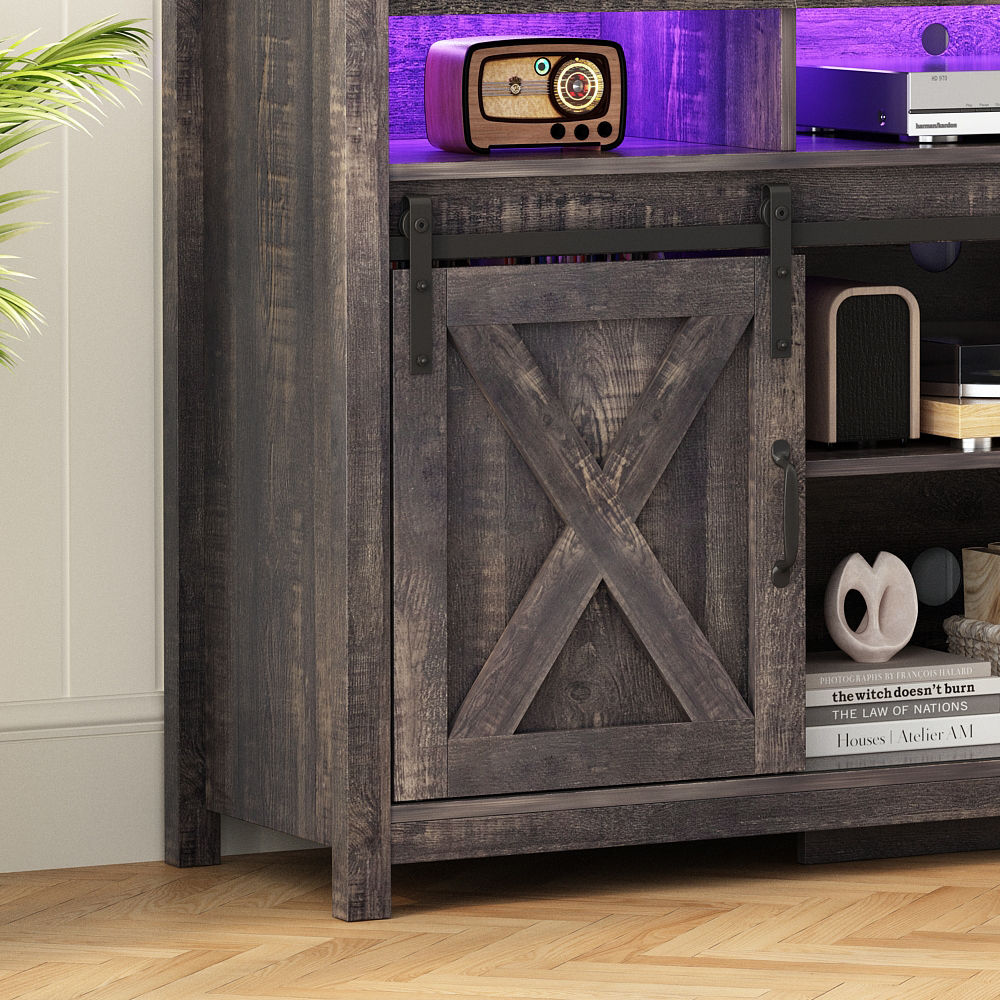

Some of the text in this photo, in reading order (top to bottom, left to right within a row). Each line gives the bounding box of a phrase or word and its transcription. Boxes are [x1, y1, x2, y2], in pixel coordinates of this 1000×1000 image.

[820, 672, 883, 686] PHOTOGRAPHS
[884, 672, 895, 681] BY
[939, 665, 973, 677] HALARD
[832, 690, 854, 703] the
[855, 687, 892, 700] witch
[945, 682, 975, 694] burn
[832, 700, 968, 721] THE LAW OF NATIONS
[837, 732, 886, 748] Houses
[898, 726, 944, 744] Atelier
[946, 723, 973, 740] AM
